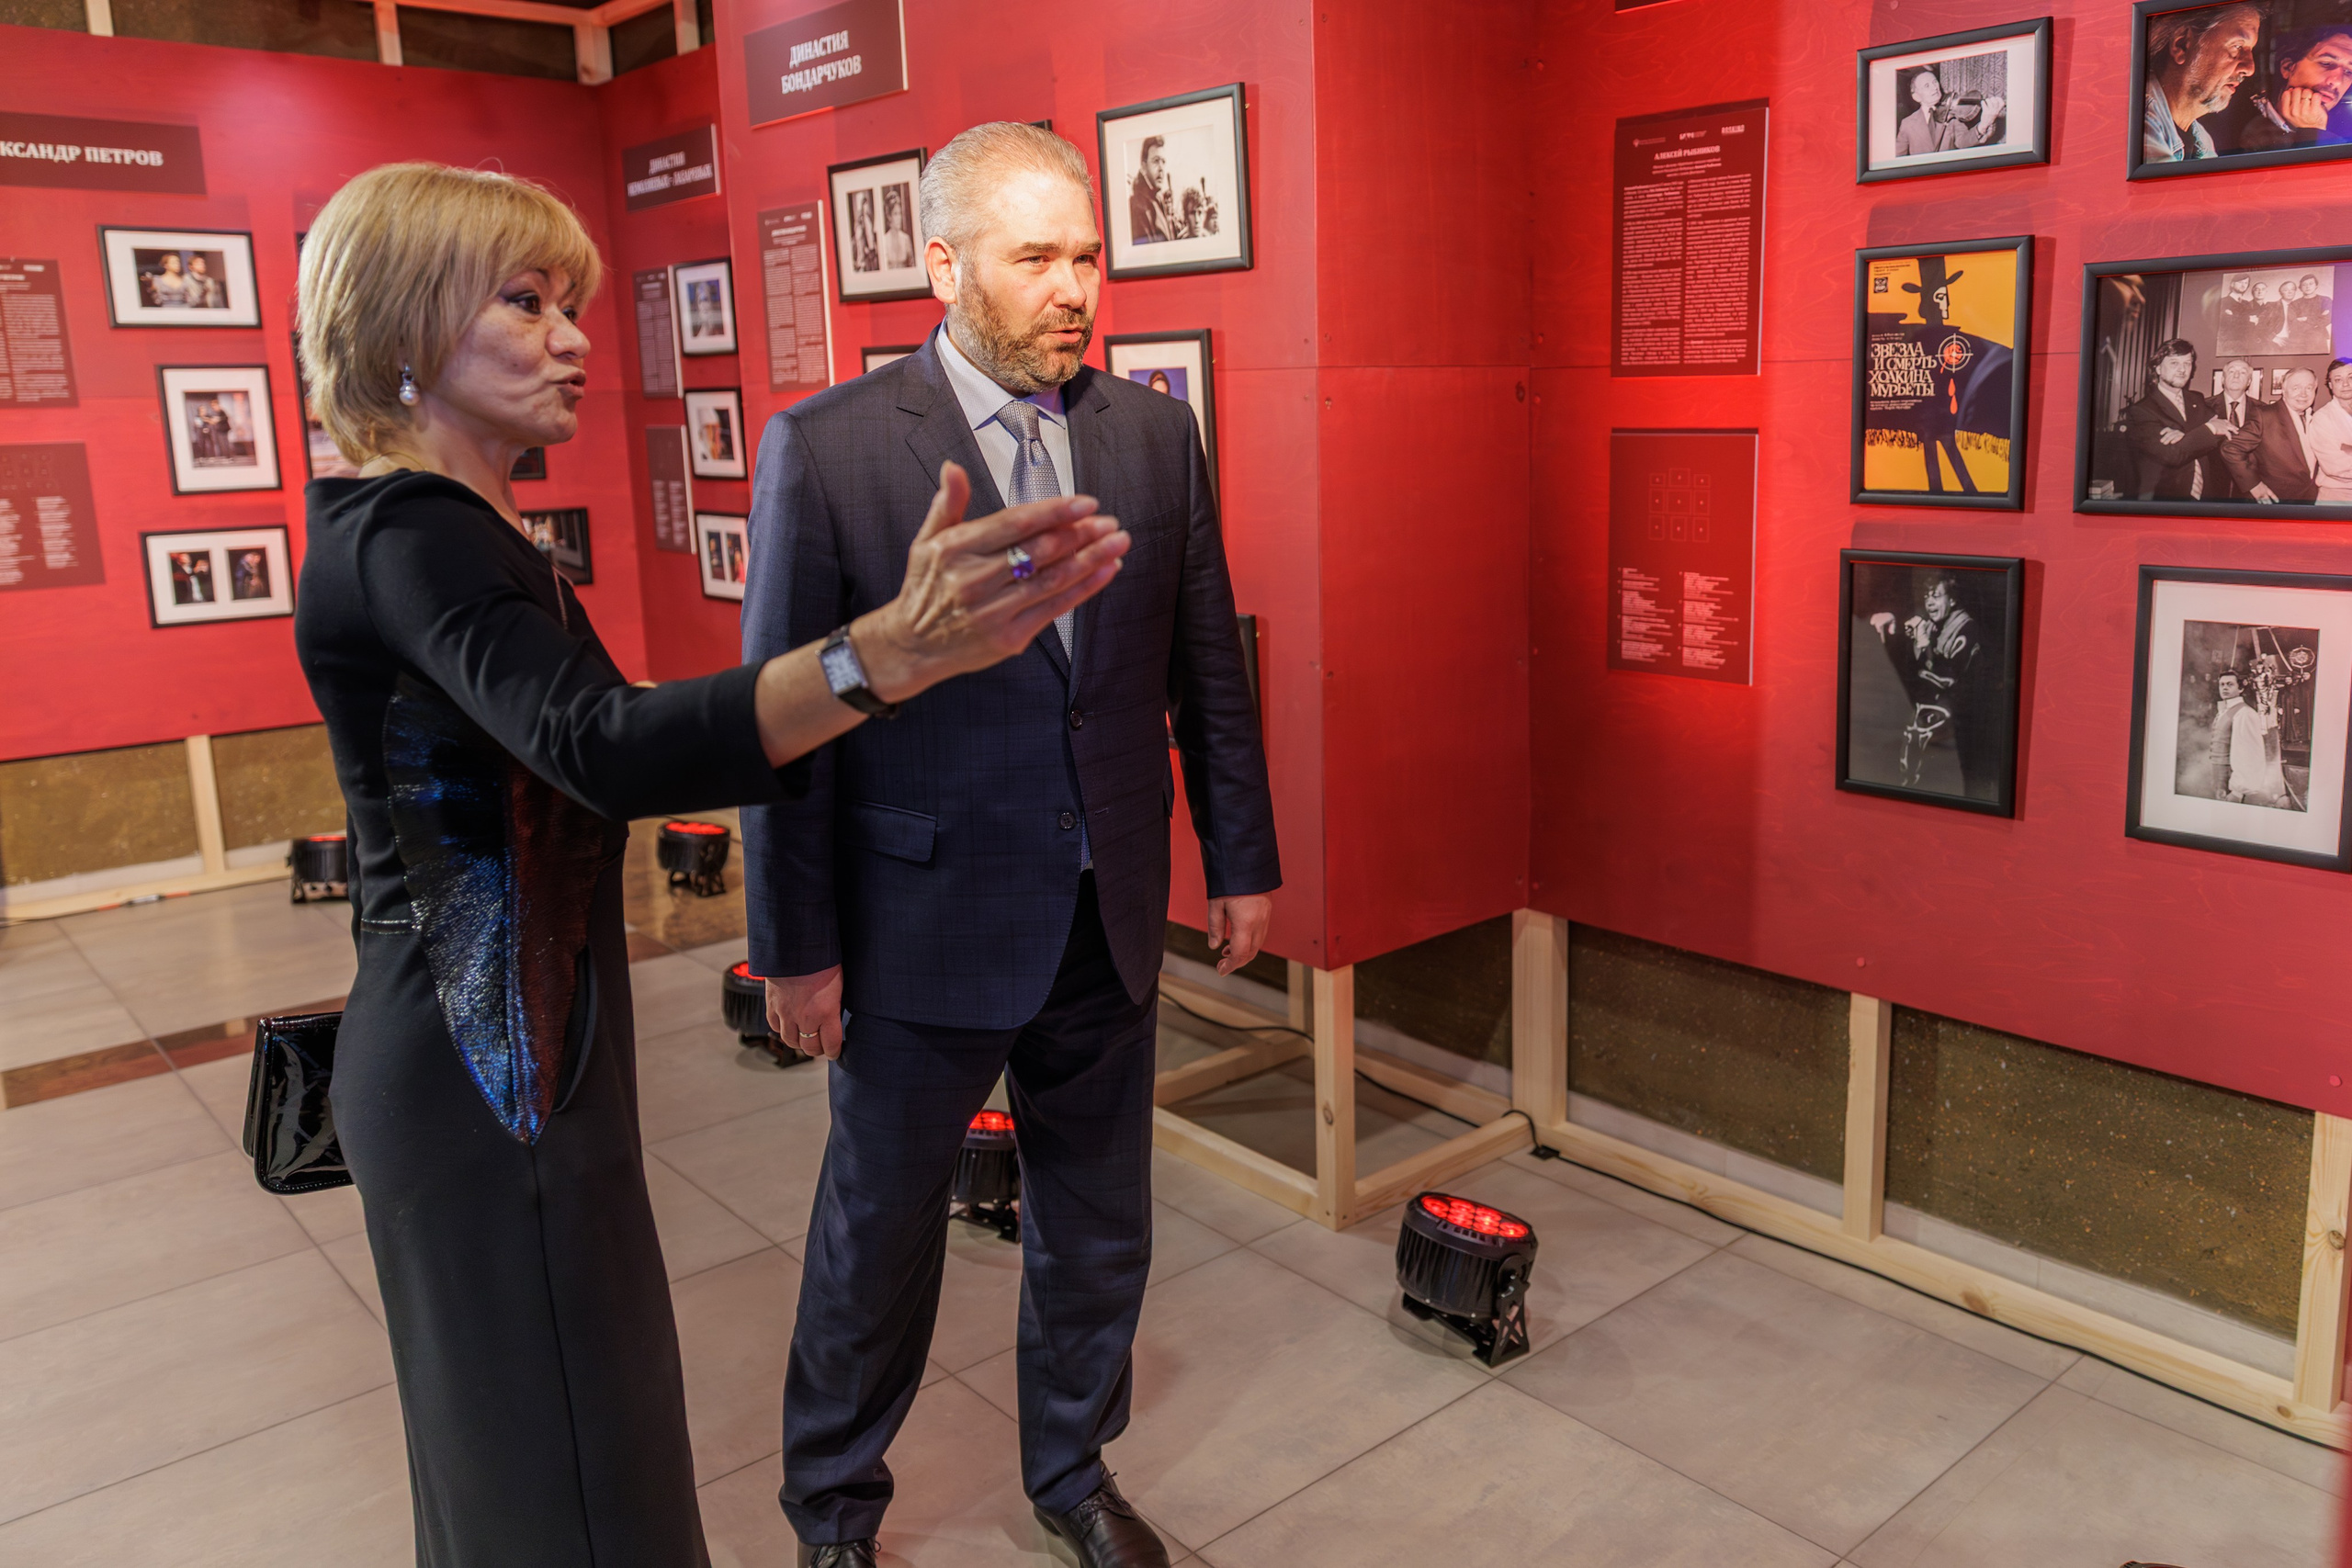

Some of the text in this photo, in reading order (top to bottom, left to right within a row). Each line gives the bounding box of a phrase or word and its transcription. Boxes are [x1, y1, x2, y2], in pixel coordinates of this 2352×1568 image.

[789, 30, 849, 69] ДИНАСТИЯ
[781, 55, 862, 95] БОНДАРЧУКОВ
[85, 146, 164, 166] ПЕТРОВ
[1654, 145, 1720, 160] АЛЕКСЕЙ РЫБНИКОВ
[1871, 342, 1926, 358] ЗВЕЗДА
[1873, 355, 1938, 370] И СМЕРТЬ
[1868, 369, 1933, 384] ХОАКИНА
[1871, 383, 1936, 397] МУРЬЕТЫ
